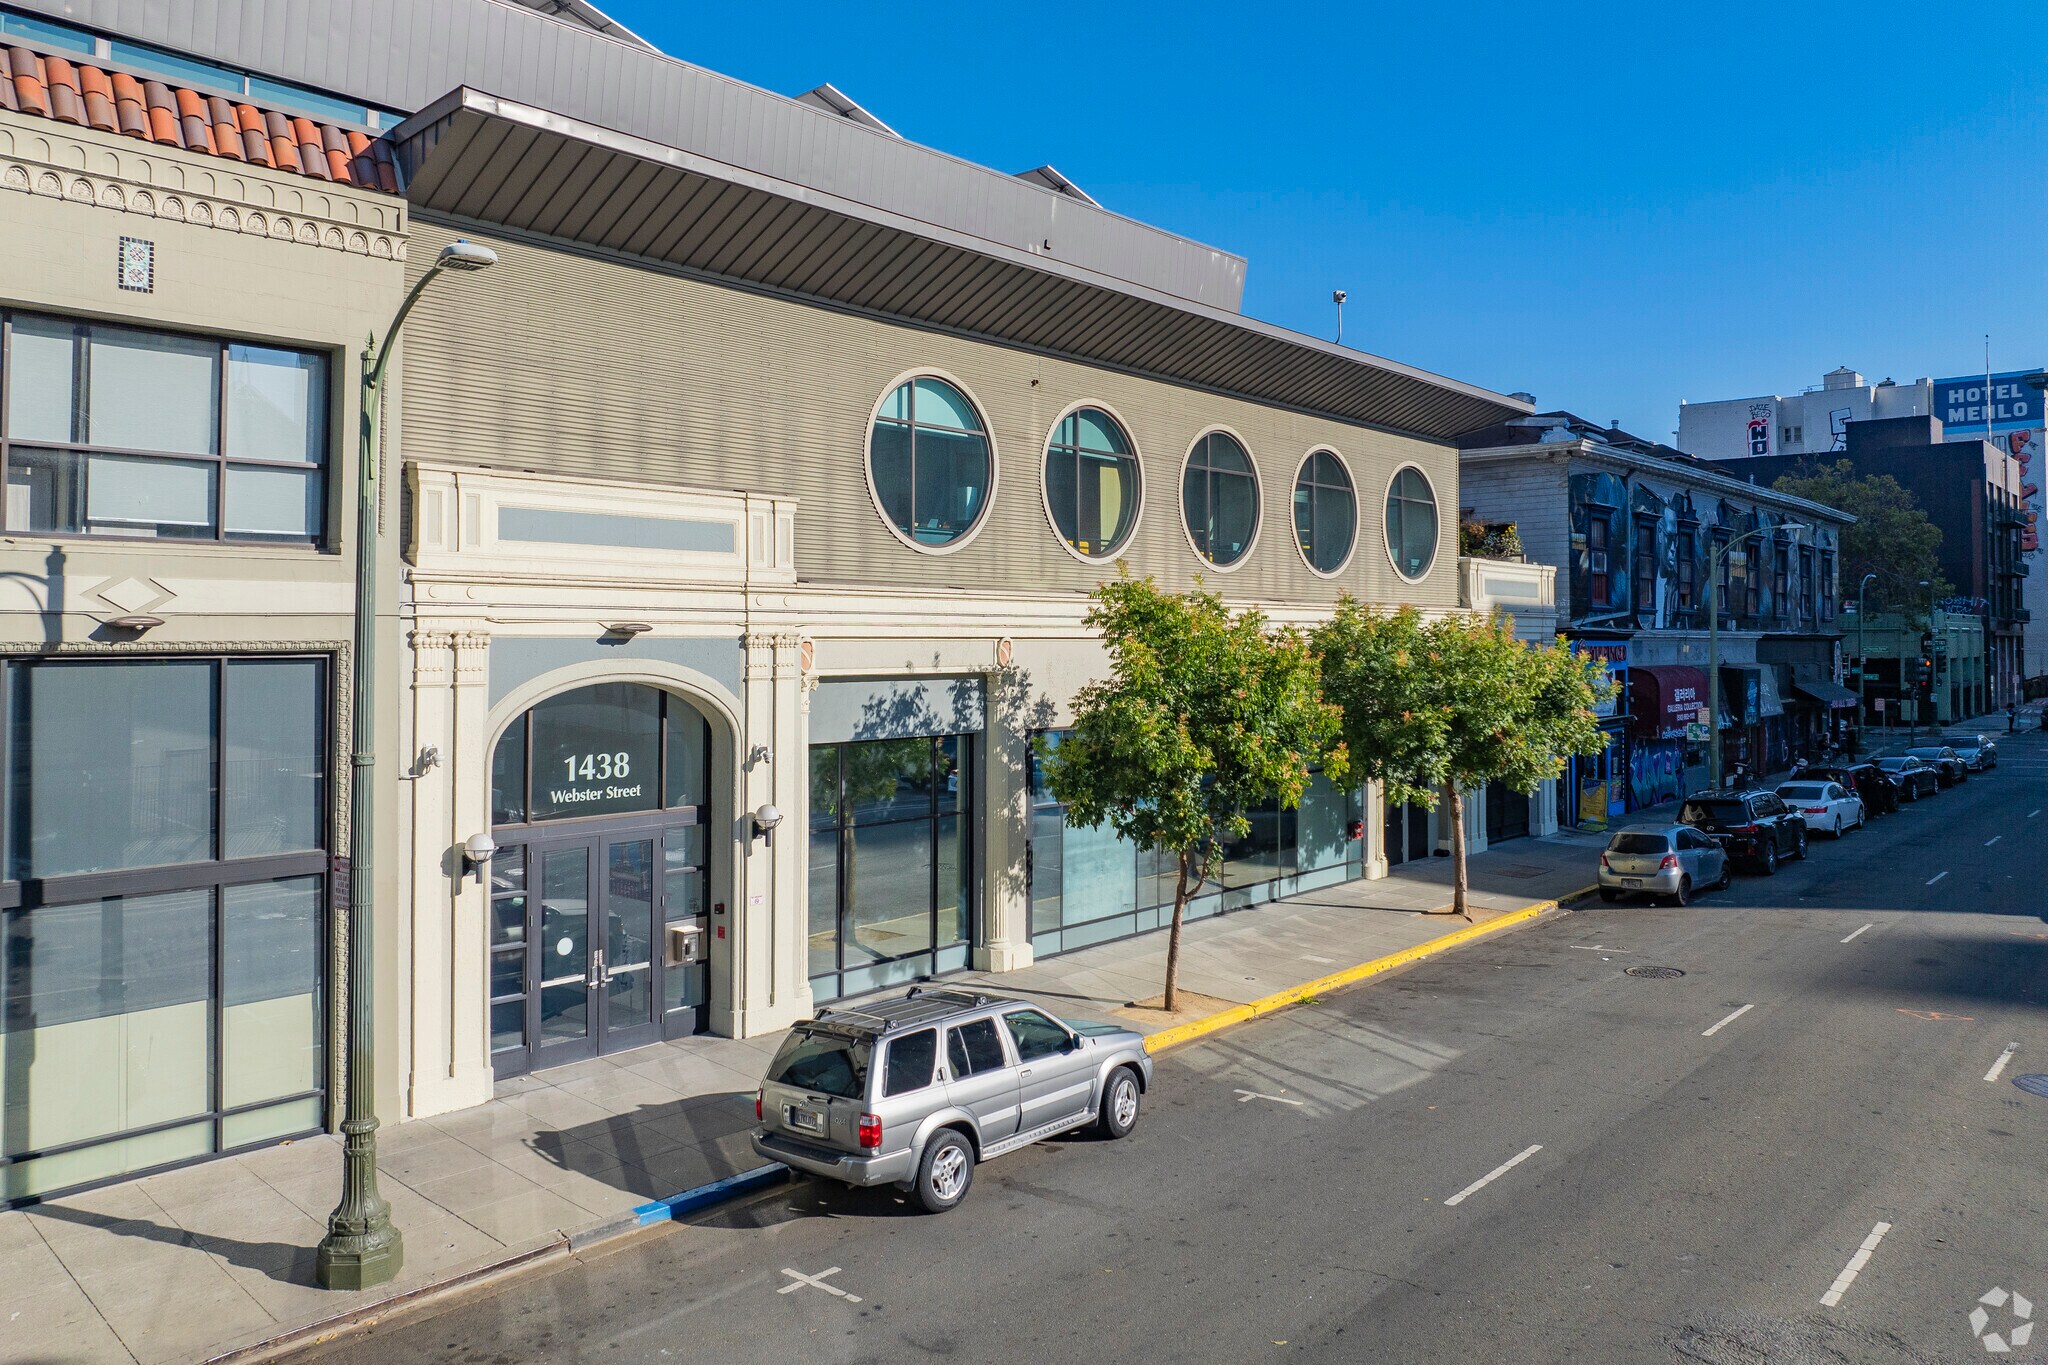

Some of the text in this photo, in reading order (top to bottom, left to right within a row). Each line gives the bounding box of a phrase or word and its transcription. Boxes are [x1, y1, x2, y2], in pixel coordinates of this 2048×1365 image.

[1948, 384, 2023, 404] HOTEL
[1948, 402, 2028, 422] MENLO
[564, 752, 630, 781] 1438
[551, 784, 642, 804] Webster Street
